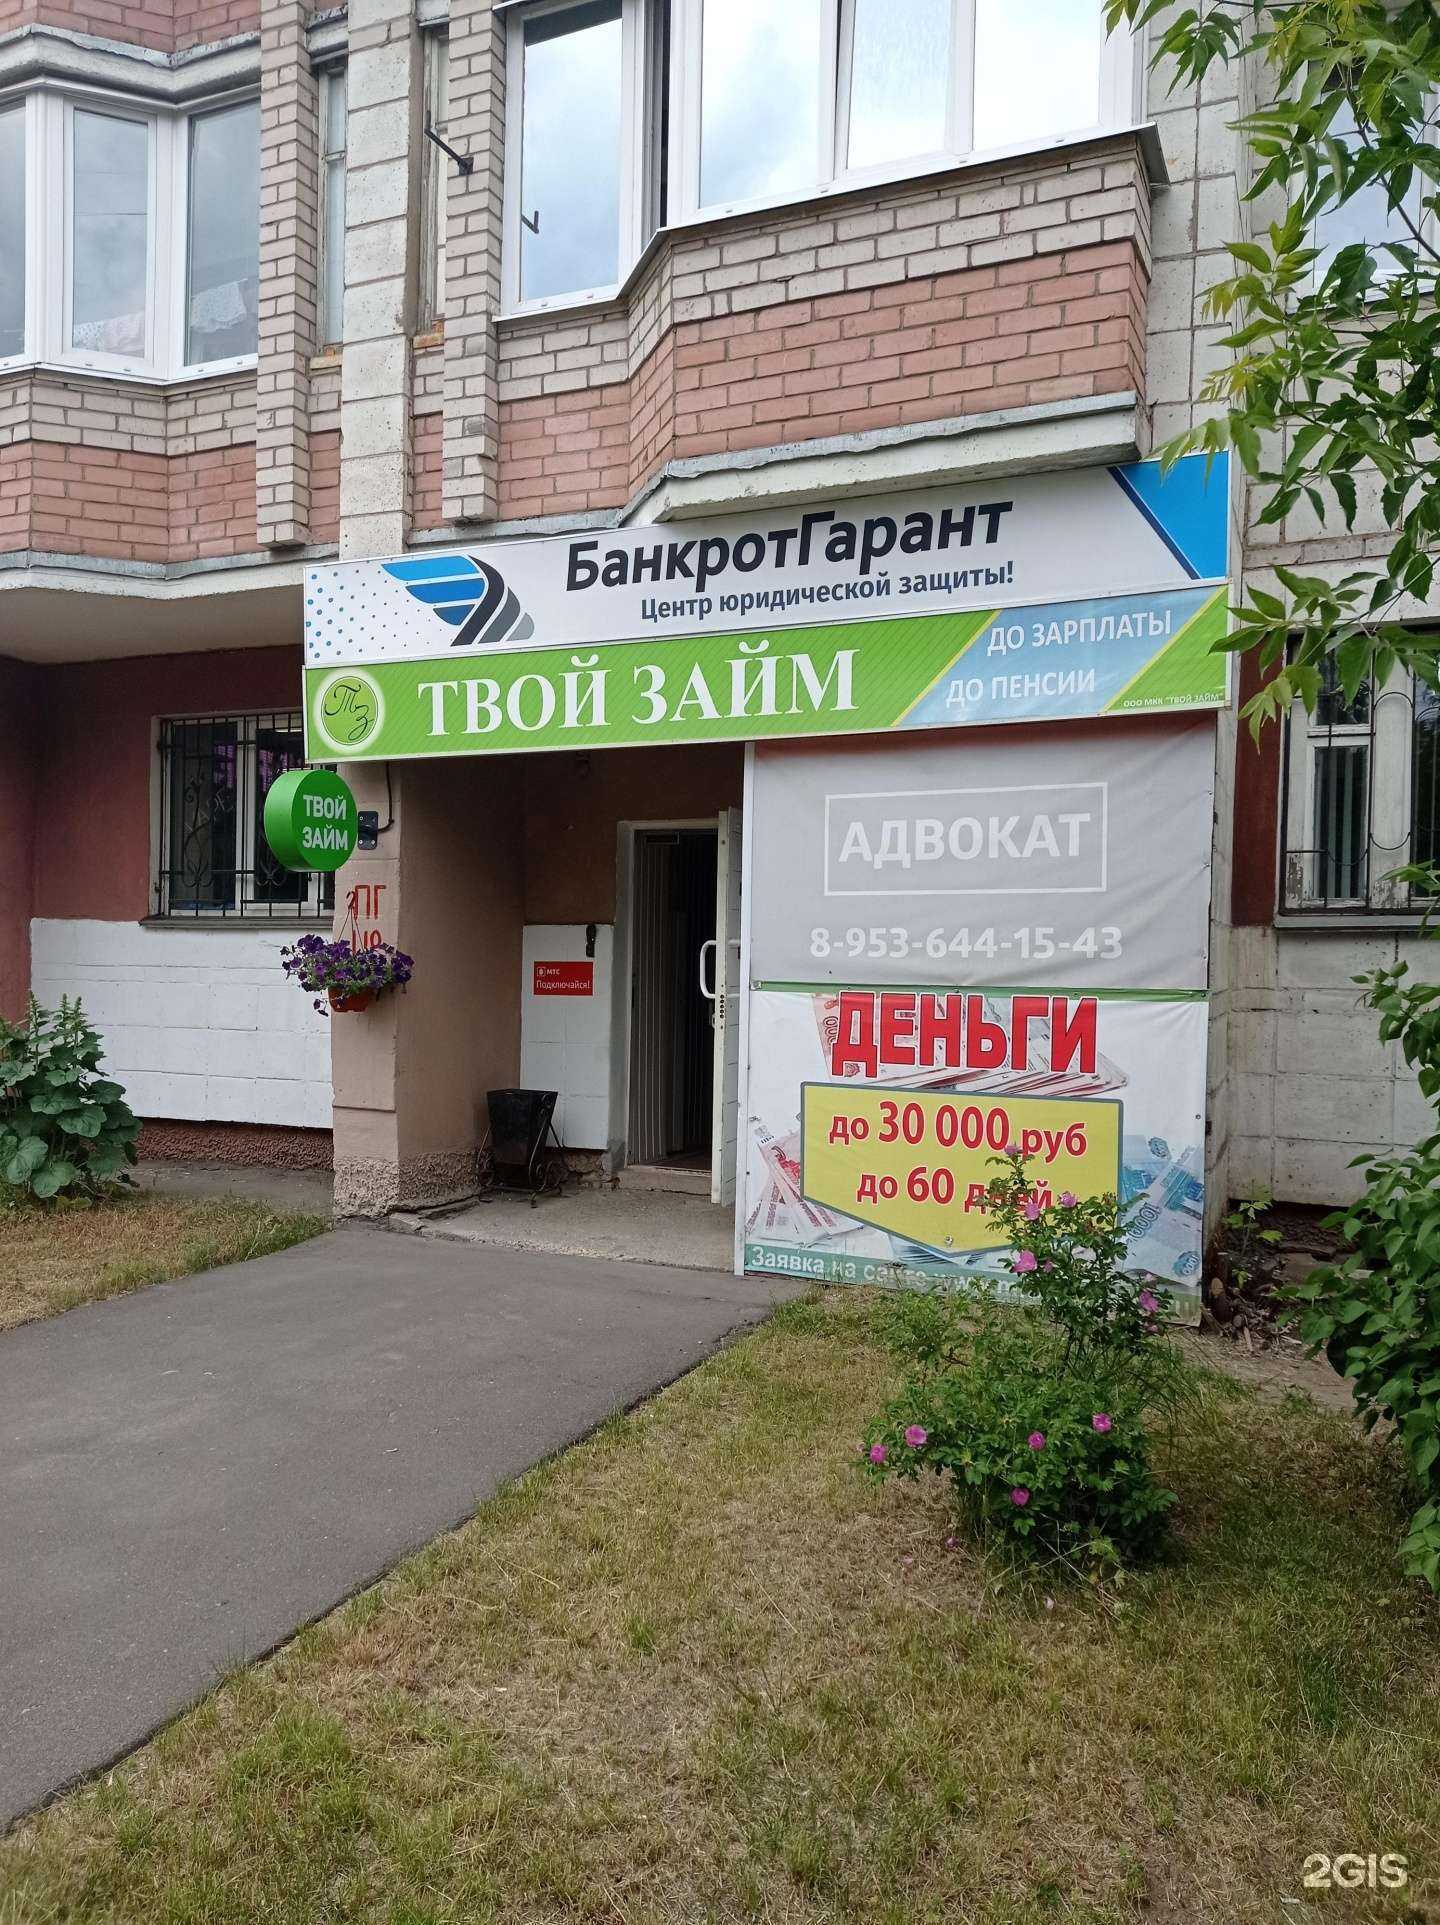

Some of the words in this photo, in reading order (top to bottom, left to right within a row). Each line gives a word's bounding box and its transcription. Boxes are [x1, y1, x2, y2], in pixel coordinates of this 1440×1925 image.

[566, 500, 1014, 594] БанкротГарант
[641, 596, 713, 623] Центр
[719, 573, 891, 611] юридической
[898, 560, 1014, 594] защиты!
[986, 626, 1025, 656] ДО
[1032, 608, 1172, 648] ЗАРПЛАТЫ
[418, 654, 612, 737] ТВОЙ
[631, 638, 861, 725] ЗАЙМ
[945, 678, 984, 707] ДО
[991, 668, 1096, 700] ПЕНСИИ
[303, 795, 347, 820] ТВОЙ
[302, 826, 349, 851] ЗАЙМ
[838, 813, 1091, 869] АДВОКАТ
[809, 926, 1123, 960] 8-953-644-15-43
[536, 980, 591, 990] Подключайся!
[831, 991, 1099, 1078] ДЕНЬГИ
[828, 1116, 870, 1145] до
[878, 1101, 925, 1145] 30
[935, 1104, 1010, 1150] 000
[1021, 1122, 1087, 1164] руб
[856, 1174, 898, 1205] до
[906, 1166, 955, 1204] 60
[752, 1247, 825, 1274] Заявка
